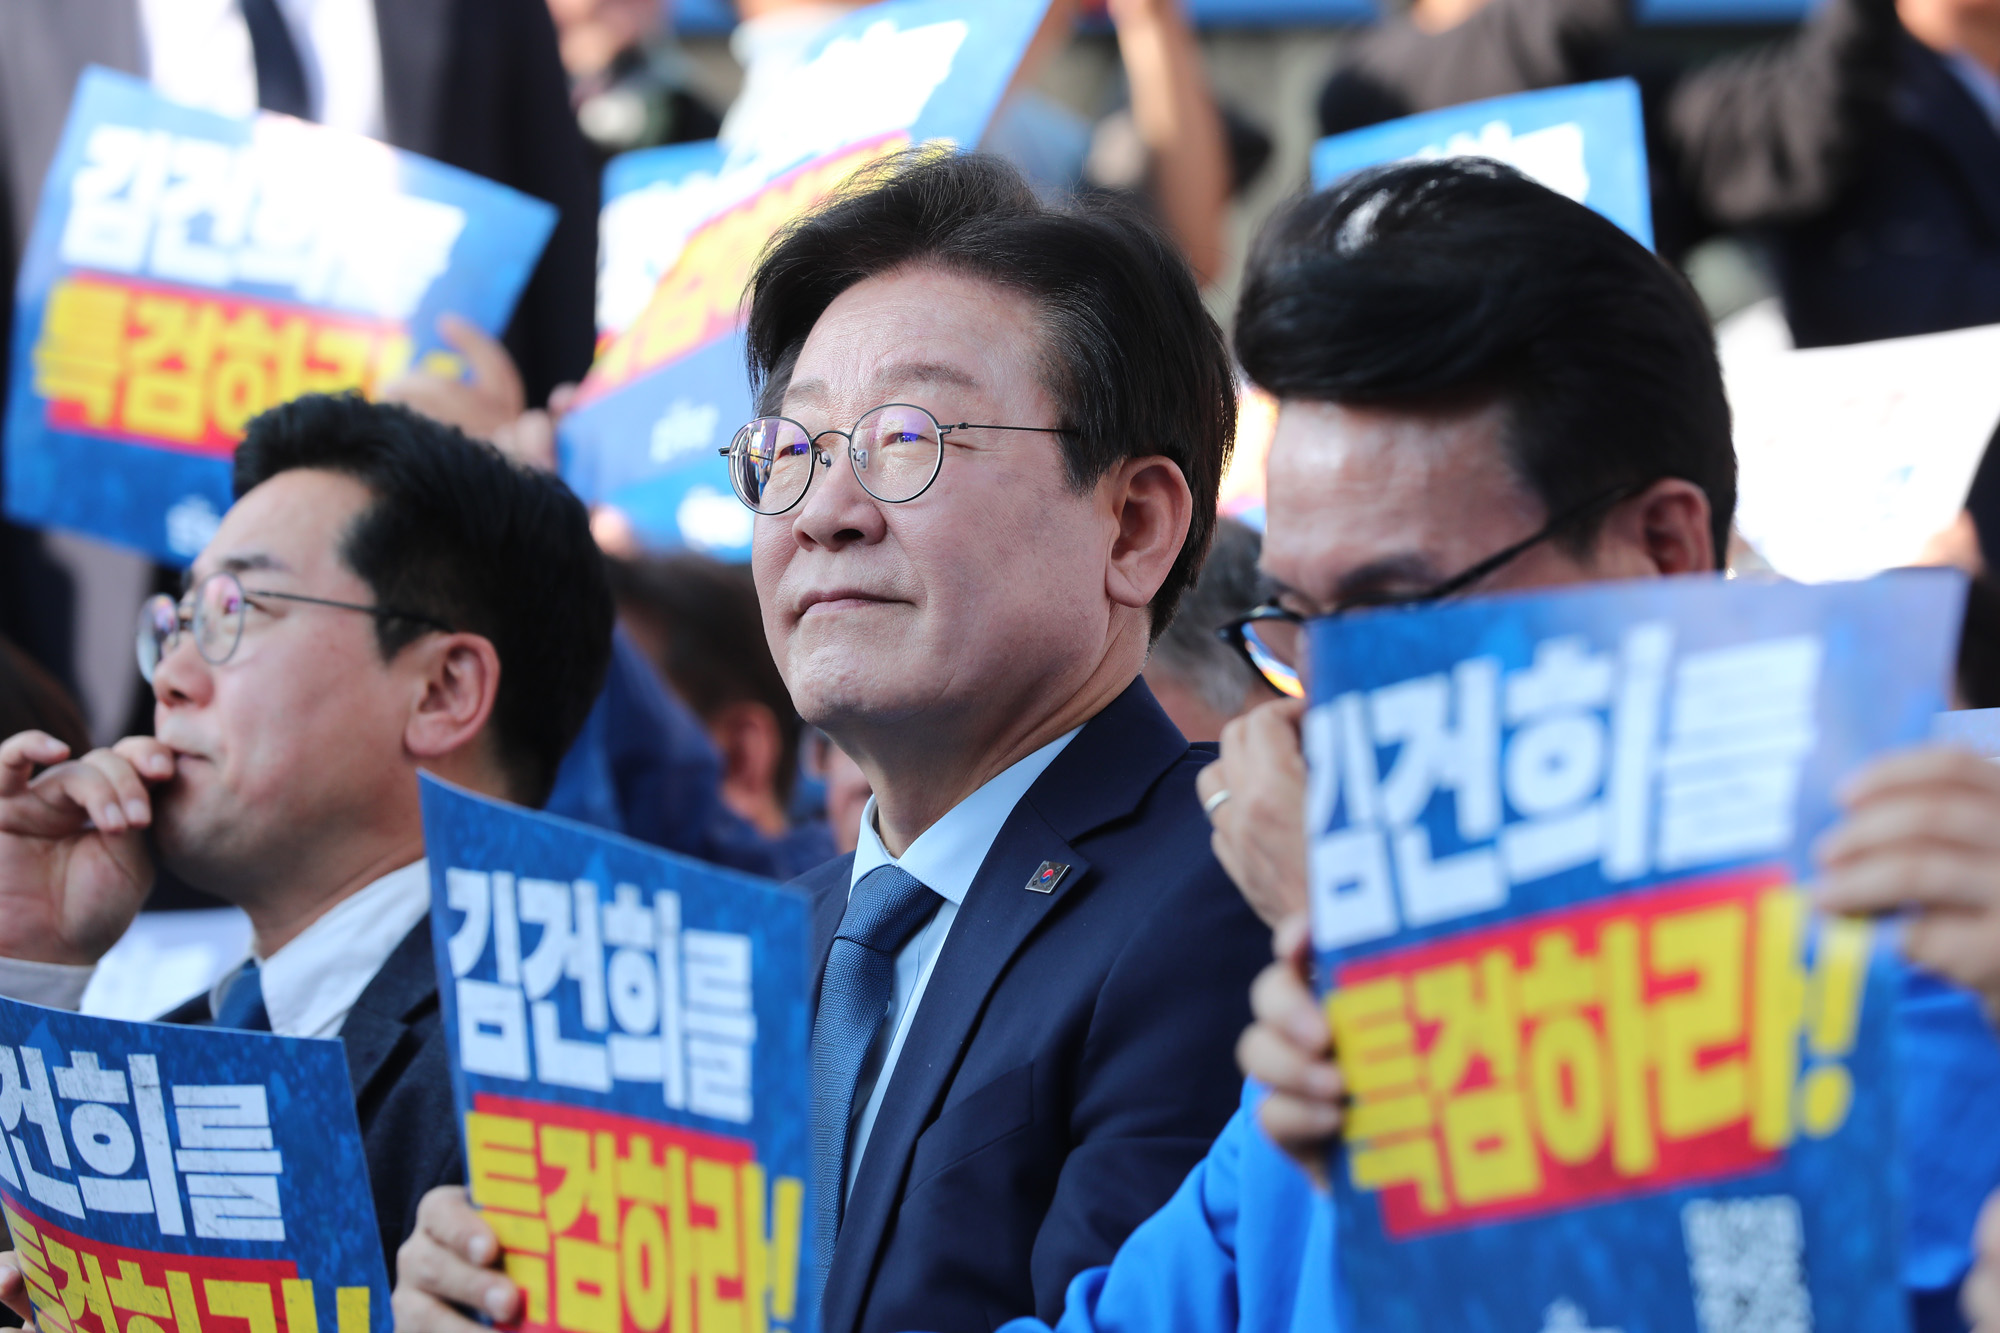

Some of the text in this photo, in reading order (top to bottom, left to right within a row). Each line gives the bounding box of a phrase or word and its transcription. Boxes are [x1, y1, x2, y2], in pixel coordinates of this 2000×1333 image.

[60, 124, 468, 322] 김건
[33, 279, 467, 442] 특검하
[445, 867, 754, 1124] 김건희를
[1325, 885, 1873, 1214] 특검하라!
[0, 1043, 286, 1242] 건희를
